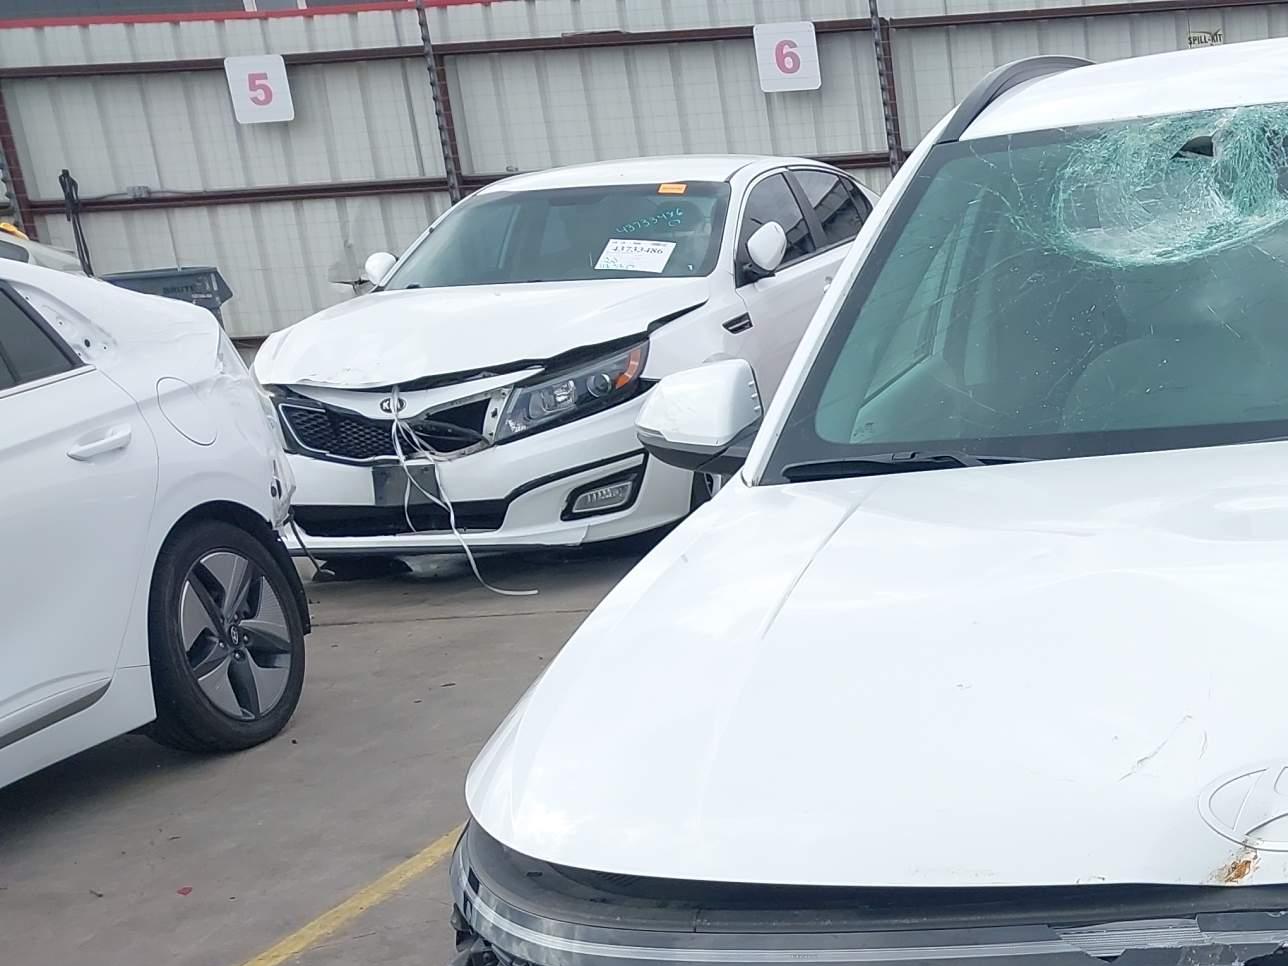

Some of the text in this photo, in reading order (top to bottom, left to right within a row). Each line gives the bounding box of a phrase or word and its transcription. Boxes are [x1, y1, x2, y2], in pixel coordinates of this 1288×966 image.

[1188, 33, 1222, 45] SPILL-KIT
[775, 39, 801, 74] 6
[247, 72, 273, 106] 5
